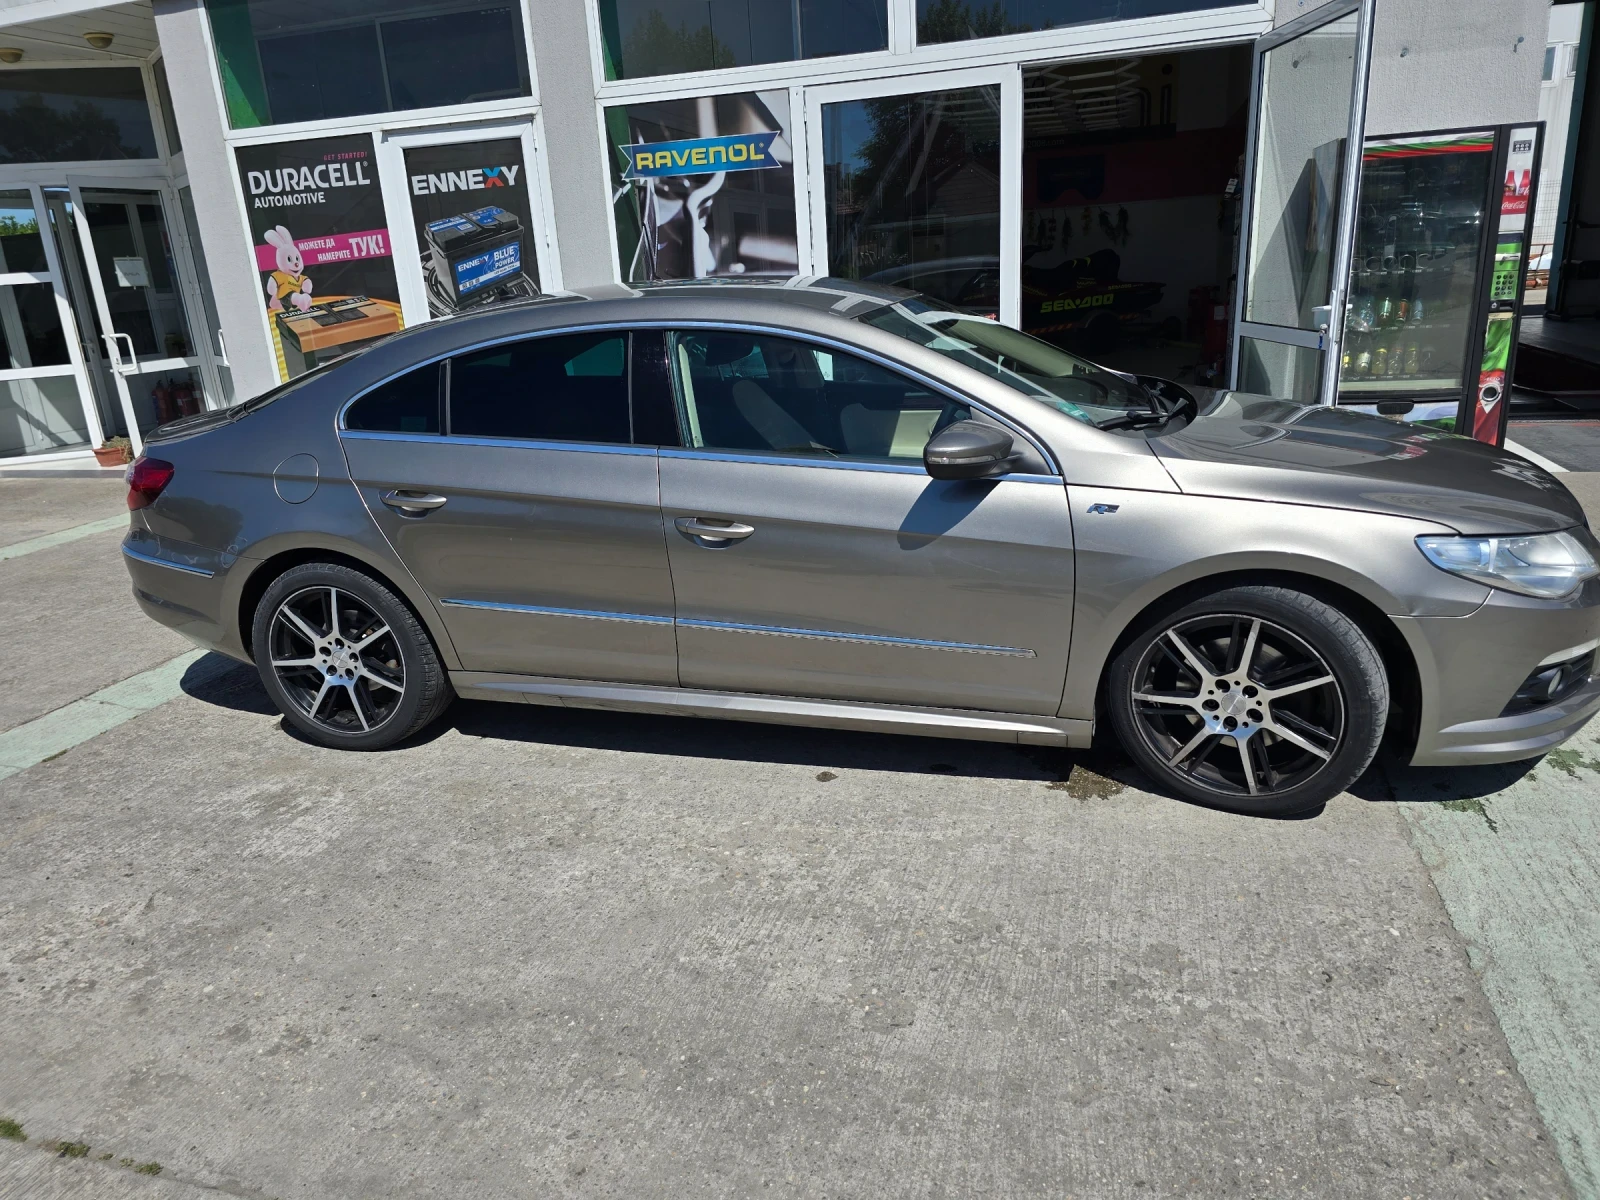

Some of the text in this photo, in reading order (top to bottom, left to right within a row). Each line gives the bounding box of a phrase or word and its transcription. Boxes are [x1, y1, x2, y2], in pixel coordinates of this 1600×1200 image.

[323, 151, 368, 161] GET STARTED!
[635, 142, 765, 170] RAVENOL
[411, 165, 519, 196] ENNEXY
[254, 191, 326, 209] AUTOMOTIVE
[298, 239, 336, 252] МОЖЕТЕ ДА
[348, 234, 385, 258] ТУК!
[493, 246, 515, 261] BLUE
[317, 249, 351, 262] НАМЕРИТЕ
[458, 254, 489, 272] ENNEXY
[494, 257, 515, 269] POWER
